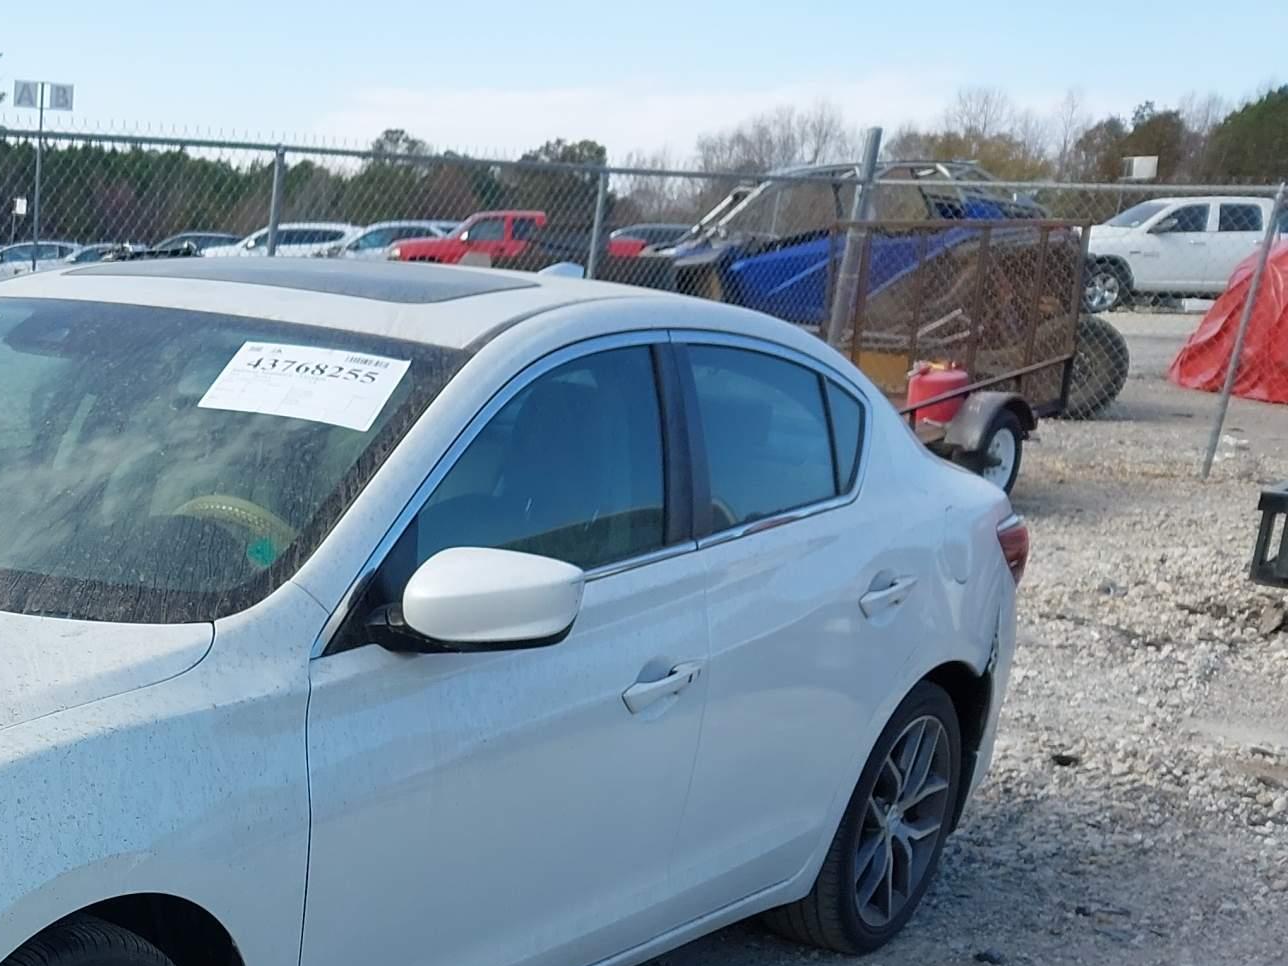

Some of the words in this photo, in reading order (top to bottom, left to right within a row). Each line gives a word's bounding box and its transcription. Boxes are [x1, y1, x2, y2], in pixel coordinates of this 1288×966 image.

[16, 83, 34, 105] A
[55, 85, 69, 108] B
[246, 356, 379, 385] 43768255
